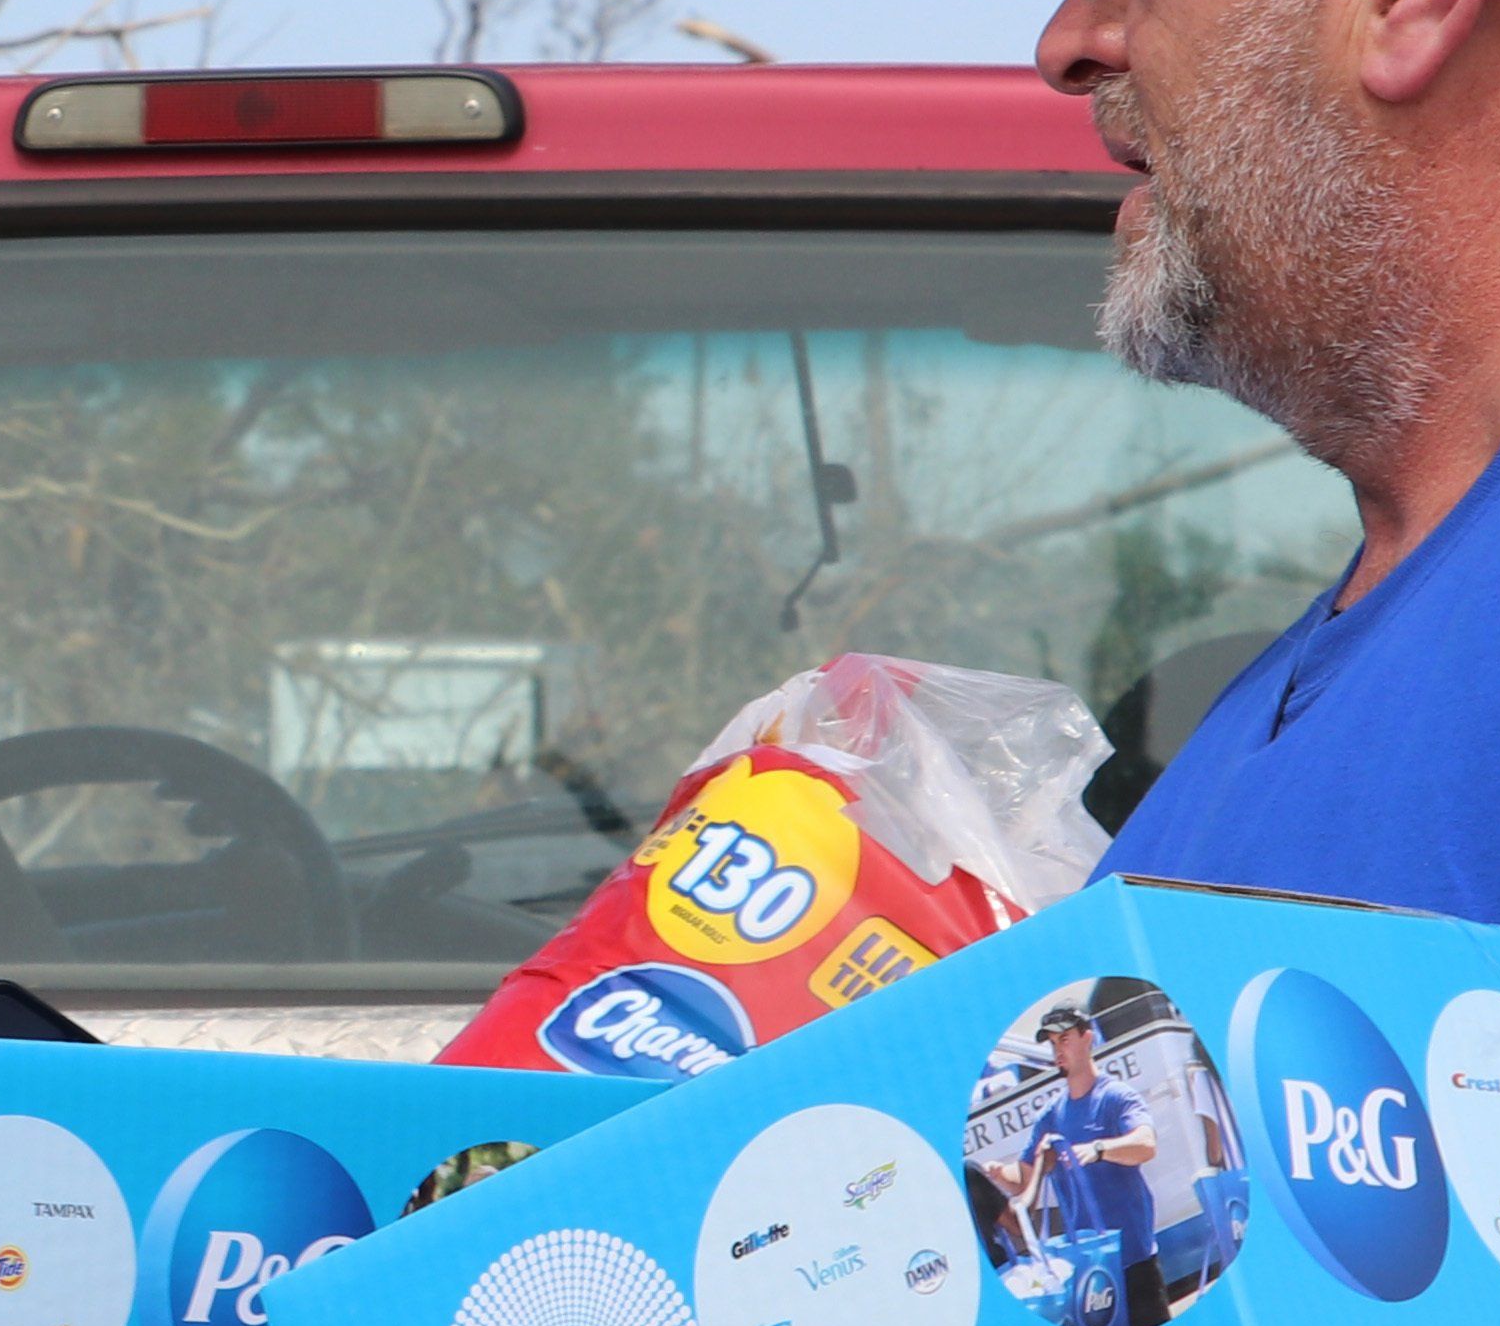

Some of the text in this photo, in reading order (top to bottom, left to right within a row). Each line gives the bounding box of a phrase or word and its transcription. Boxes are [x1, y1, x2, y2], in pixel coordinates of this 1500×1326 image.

[669, 821, 817, 943] 130
[1282, 1079, 1418, 1190] P&G
[33, 1202, 95, 1219] TAMPAX
[731, 1223, 790, 1260] Gillette
[795, 1254, 867, 1292] Venus
[903, 1254, 950, 1289] DAWN
[1084, 1276, 1113, 1313] P&G
